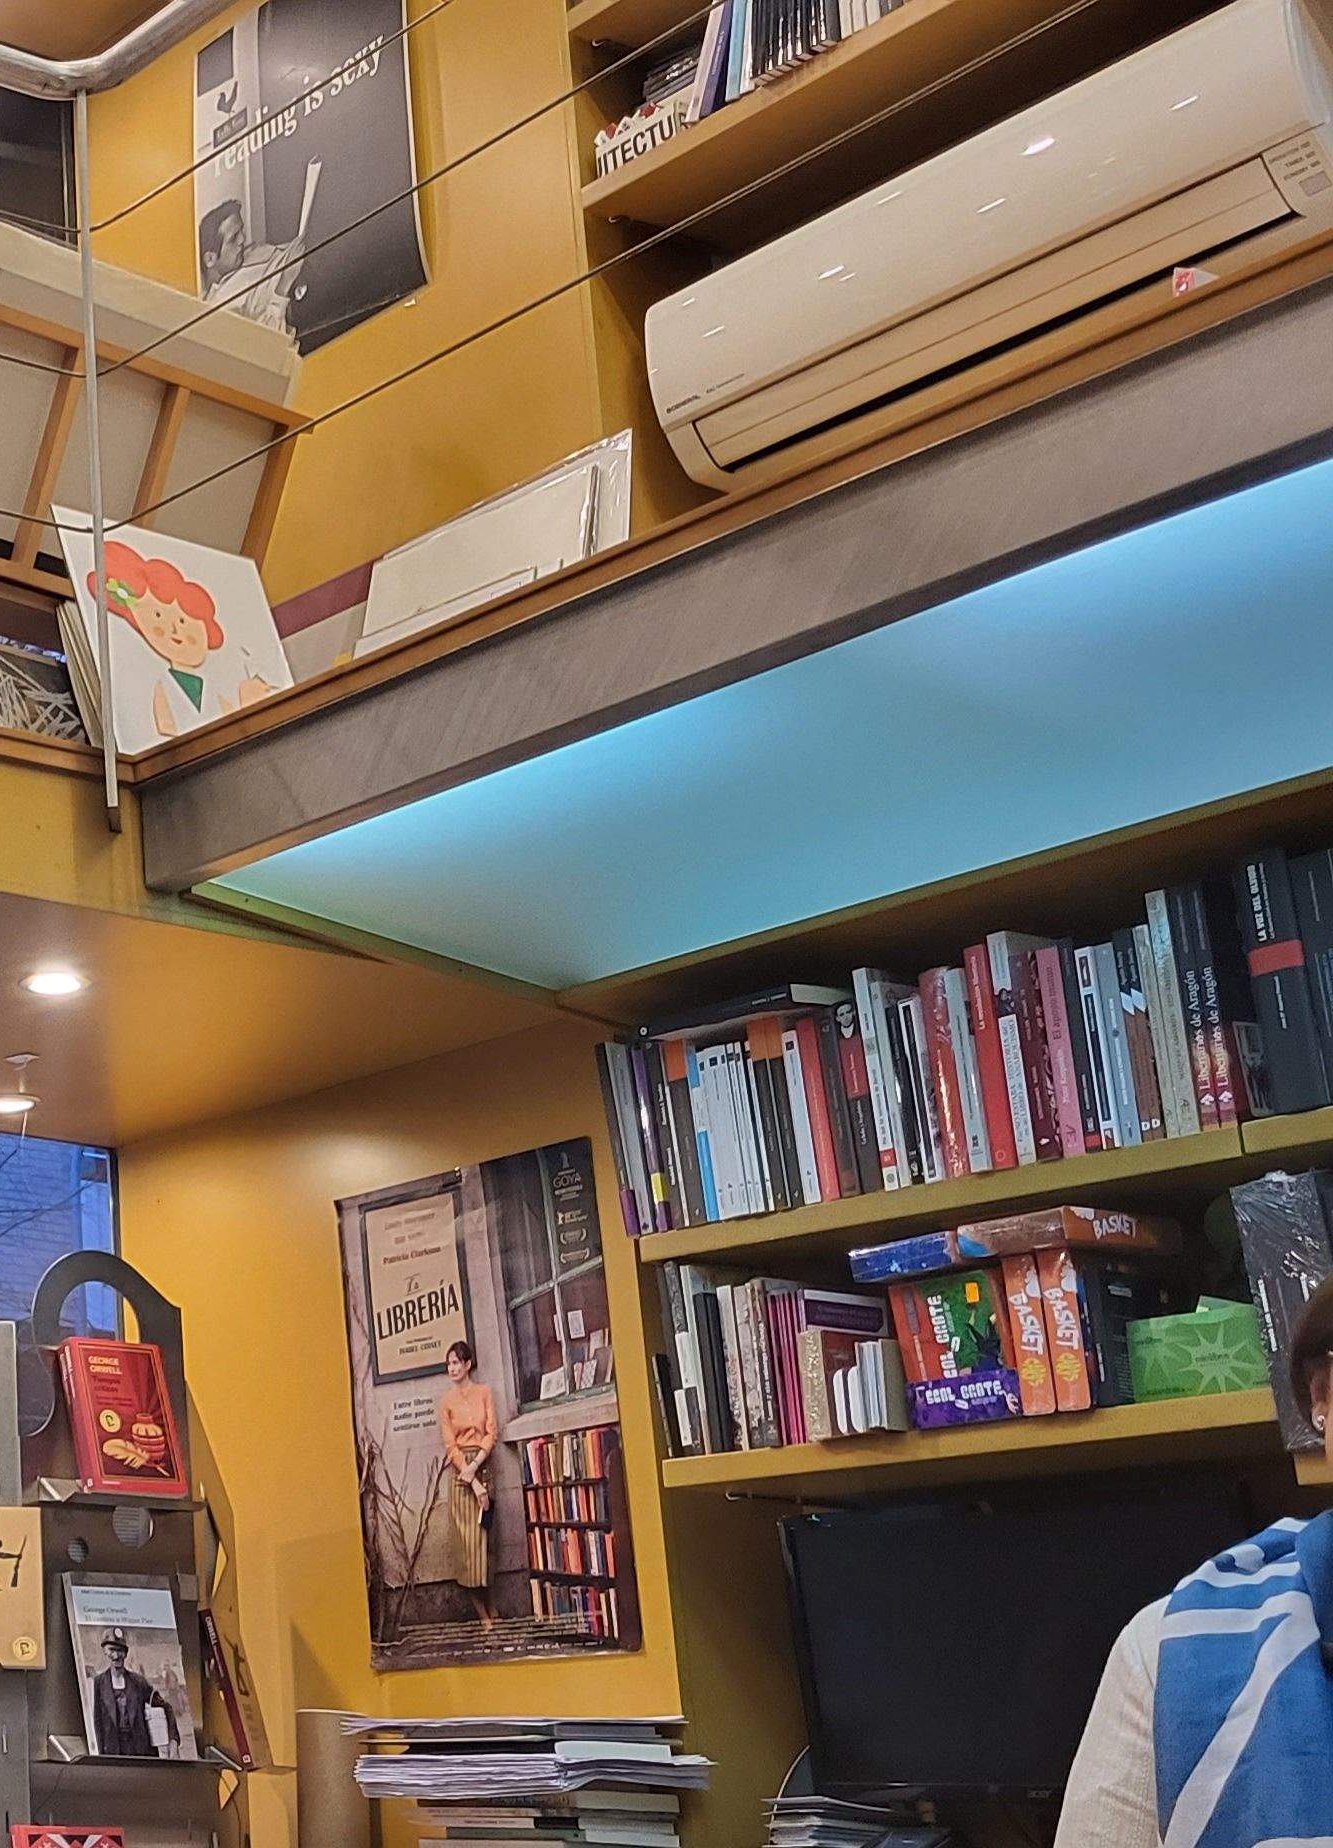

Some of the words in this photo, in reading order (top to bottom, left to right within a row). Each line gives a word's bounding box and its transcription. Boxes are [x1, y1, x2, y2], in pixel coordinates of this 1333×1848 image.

[214, 98, 298, 177] reading
[304, 76, 324, 116] is
[330, 34, 384, 96] sexy
[597, 114, 686, 177] ITECTU
[1185, 970, 1202, 1009] Aragón
[1202, 966, 1220, 1005] Aragón
[1190, 1011, 1202, 1028] de
[1208, 1007, 1220, 1024] de
[1093, 1213, 1136, 1239] BASKET
[376, 1279, 460, 1340] LIBRERÍA
[1008, 1289, 1043, 1355] BASKET
[1043, 1287, 1078, 1350] BASKET
[88, 1356, 119, 1366] GEORGE
